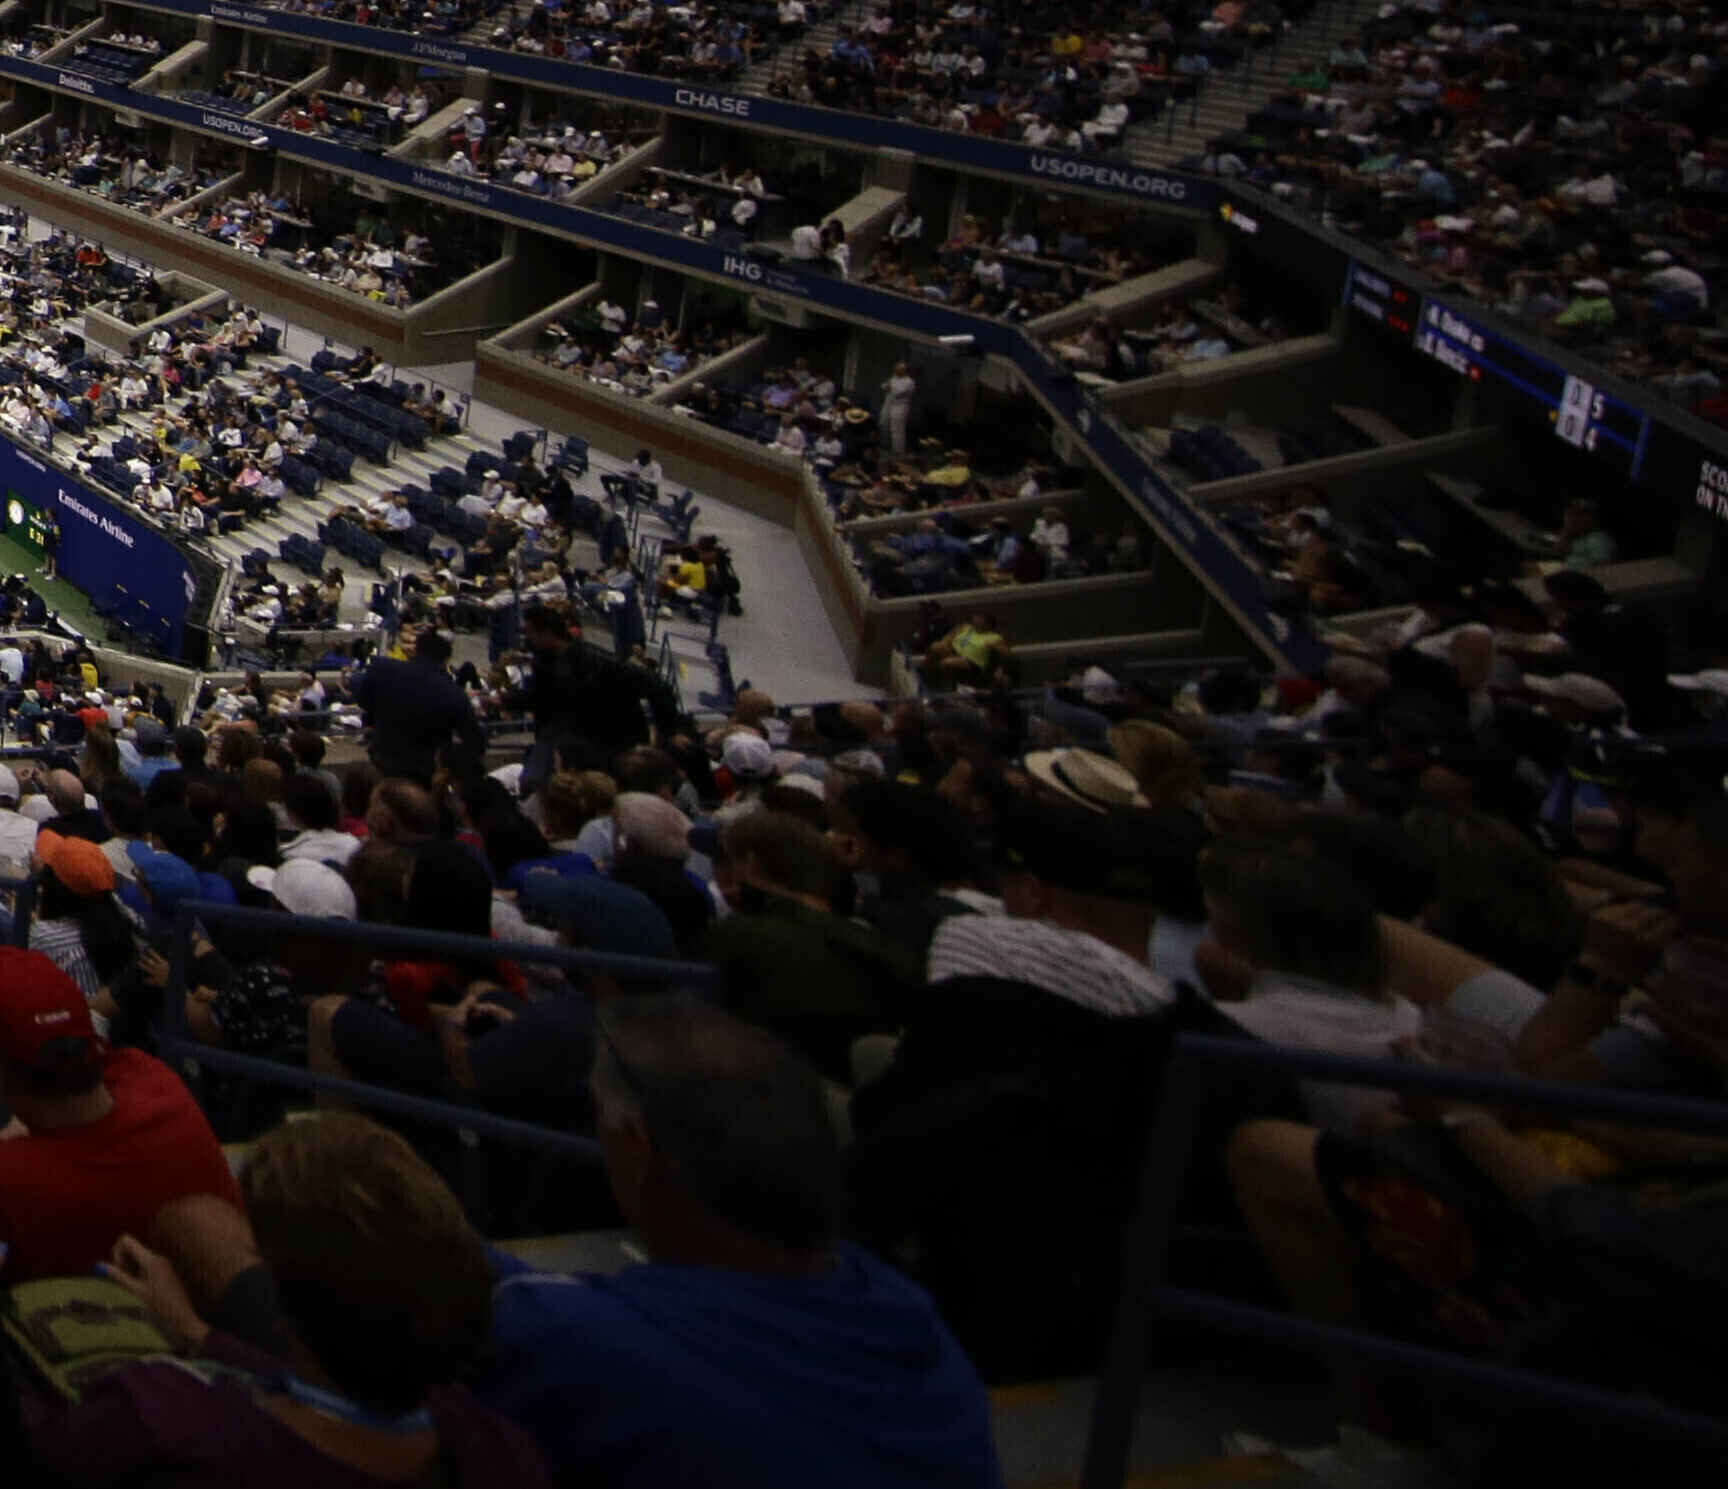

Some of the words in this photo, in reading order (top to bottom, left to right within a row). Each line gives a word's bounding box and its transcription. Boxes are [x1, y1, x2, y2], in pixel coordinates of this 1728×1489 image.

[411, 42, 467, 62] J.P.Morgan
[675, 88, 750, 117] CHASE
[202, 113, 264, 139] USOPEN.ORG
[412, 172, 491, 204] Mercedes-Benz
[1030, 155, 1186, 200] USOPEN.ORG
[724, 255, 763, 280] IHG
[1591, 392, 1606, 421] 5
[1584, 426, 1600, 453] 4
[1700, 459, 1728, 494] SCO
[57, 488, 99, 526] Emirates
[99, 517, 135, 550] Airline
